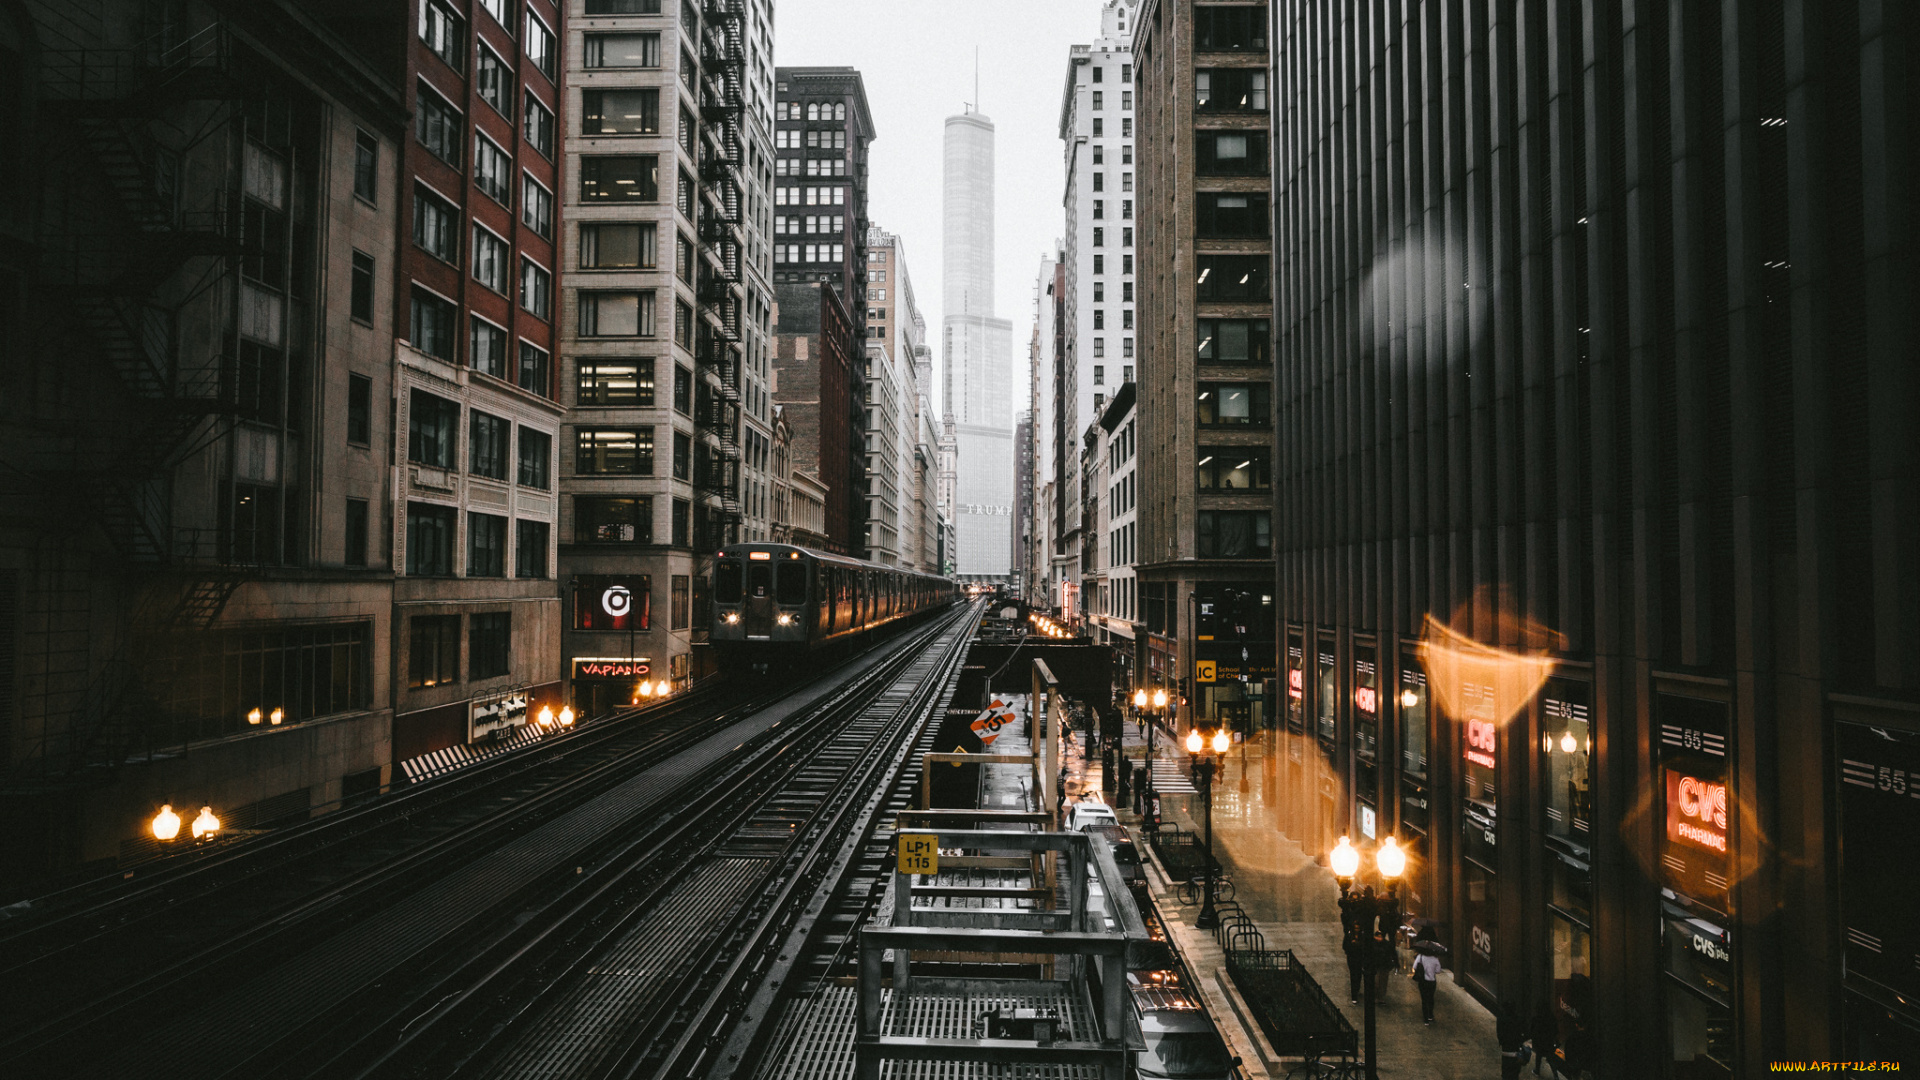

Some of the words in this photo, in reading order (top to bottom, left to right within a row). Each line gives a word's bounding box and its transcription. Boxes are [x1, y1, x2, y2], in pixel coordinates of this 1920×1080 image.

[966, 503, 1013, 516] TRUMP
[1195, 666, 1213, 679] IC
[984, 709, 1007, 732] 15
[1560, 701, 1572, 719] 55
[1468, 718, 1496, 753] CVS
[1684, 728, 1701, 751] 55
[1879, 766, 1906, 795] 55
[1679, 776, 1727, 830] CVS
[906, 841, 931, 853] LP1
[1484, 829, 1496, 846] CVS
[906, 857, 930, 869] 115
[1472, 925, 1492, 954] CVS
[1692, 934, 1715, 959] CVS
